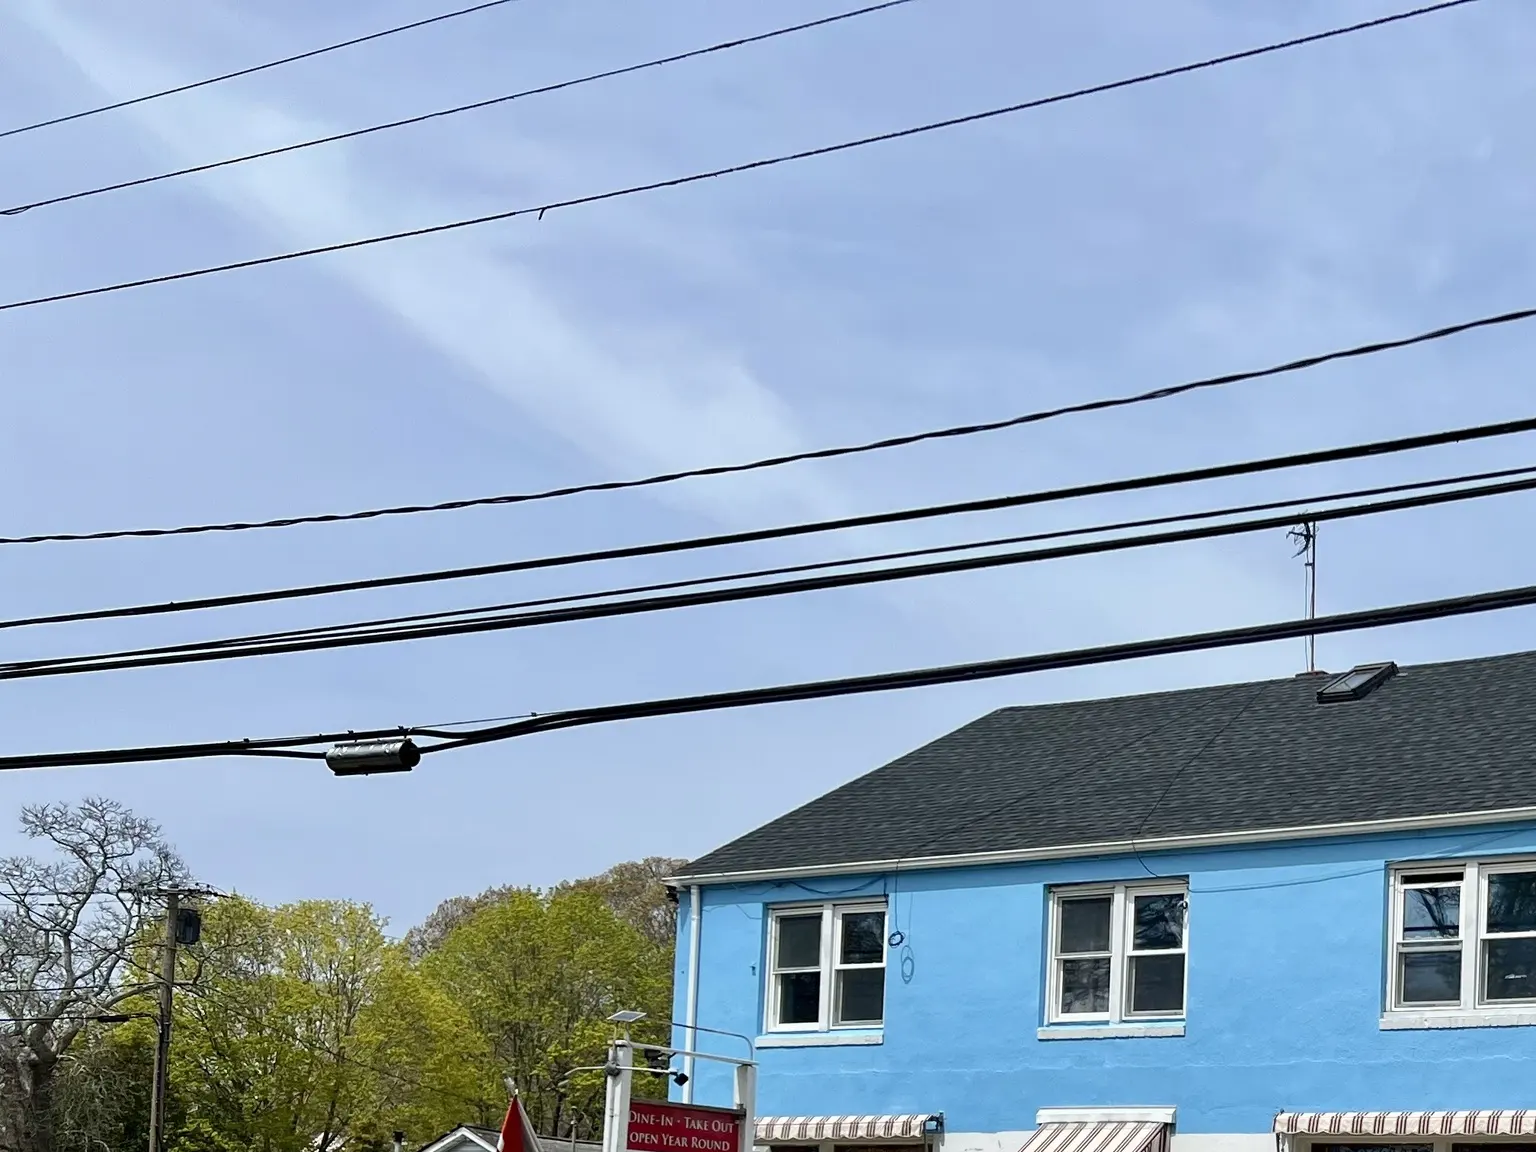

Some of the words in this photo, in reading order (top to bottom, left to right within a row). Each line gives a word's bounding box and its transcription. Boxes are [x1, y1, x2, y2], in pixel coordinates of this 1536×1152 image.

[684, 1116, 709, 1131] TAKE
[711, 1119, 735, 1134] OUT
[629, 1131, 659, 1145] OPEN
[662, 1133, 688, 1148] YEAR
[691, 1136, 731, 1152] ROUND
